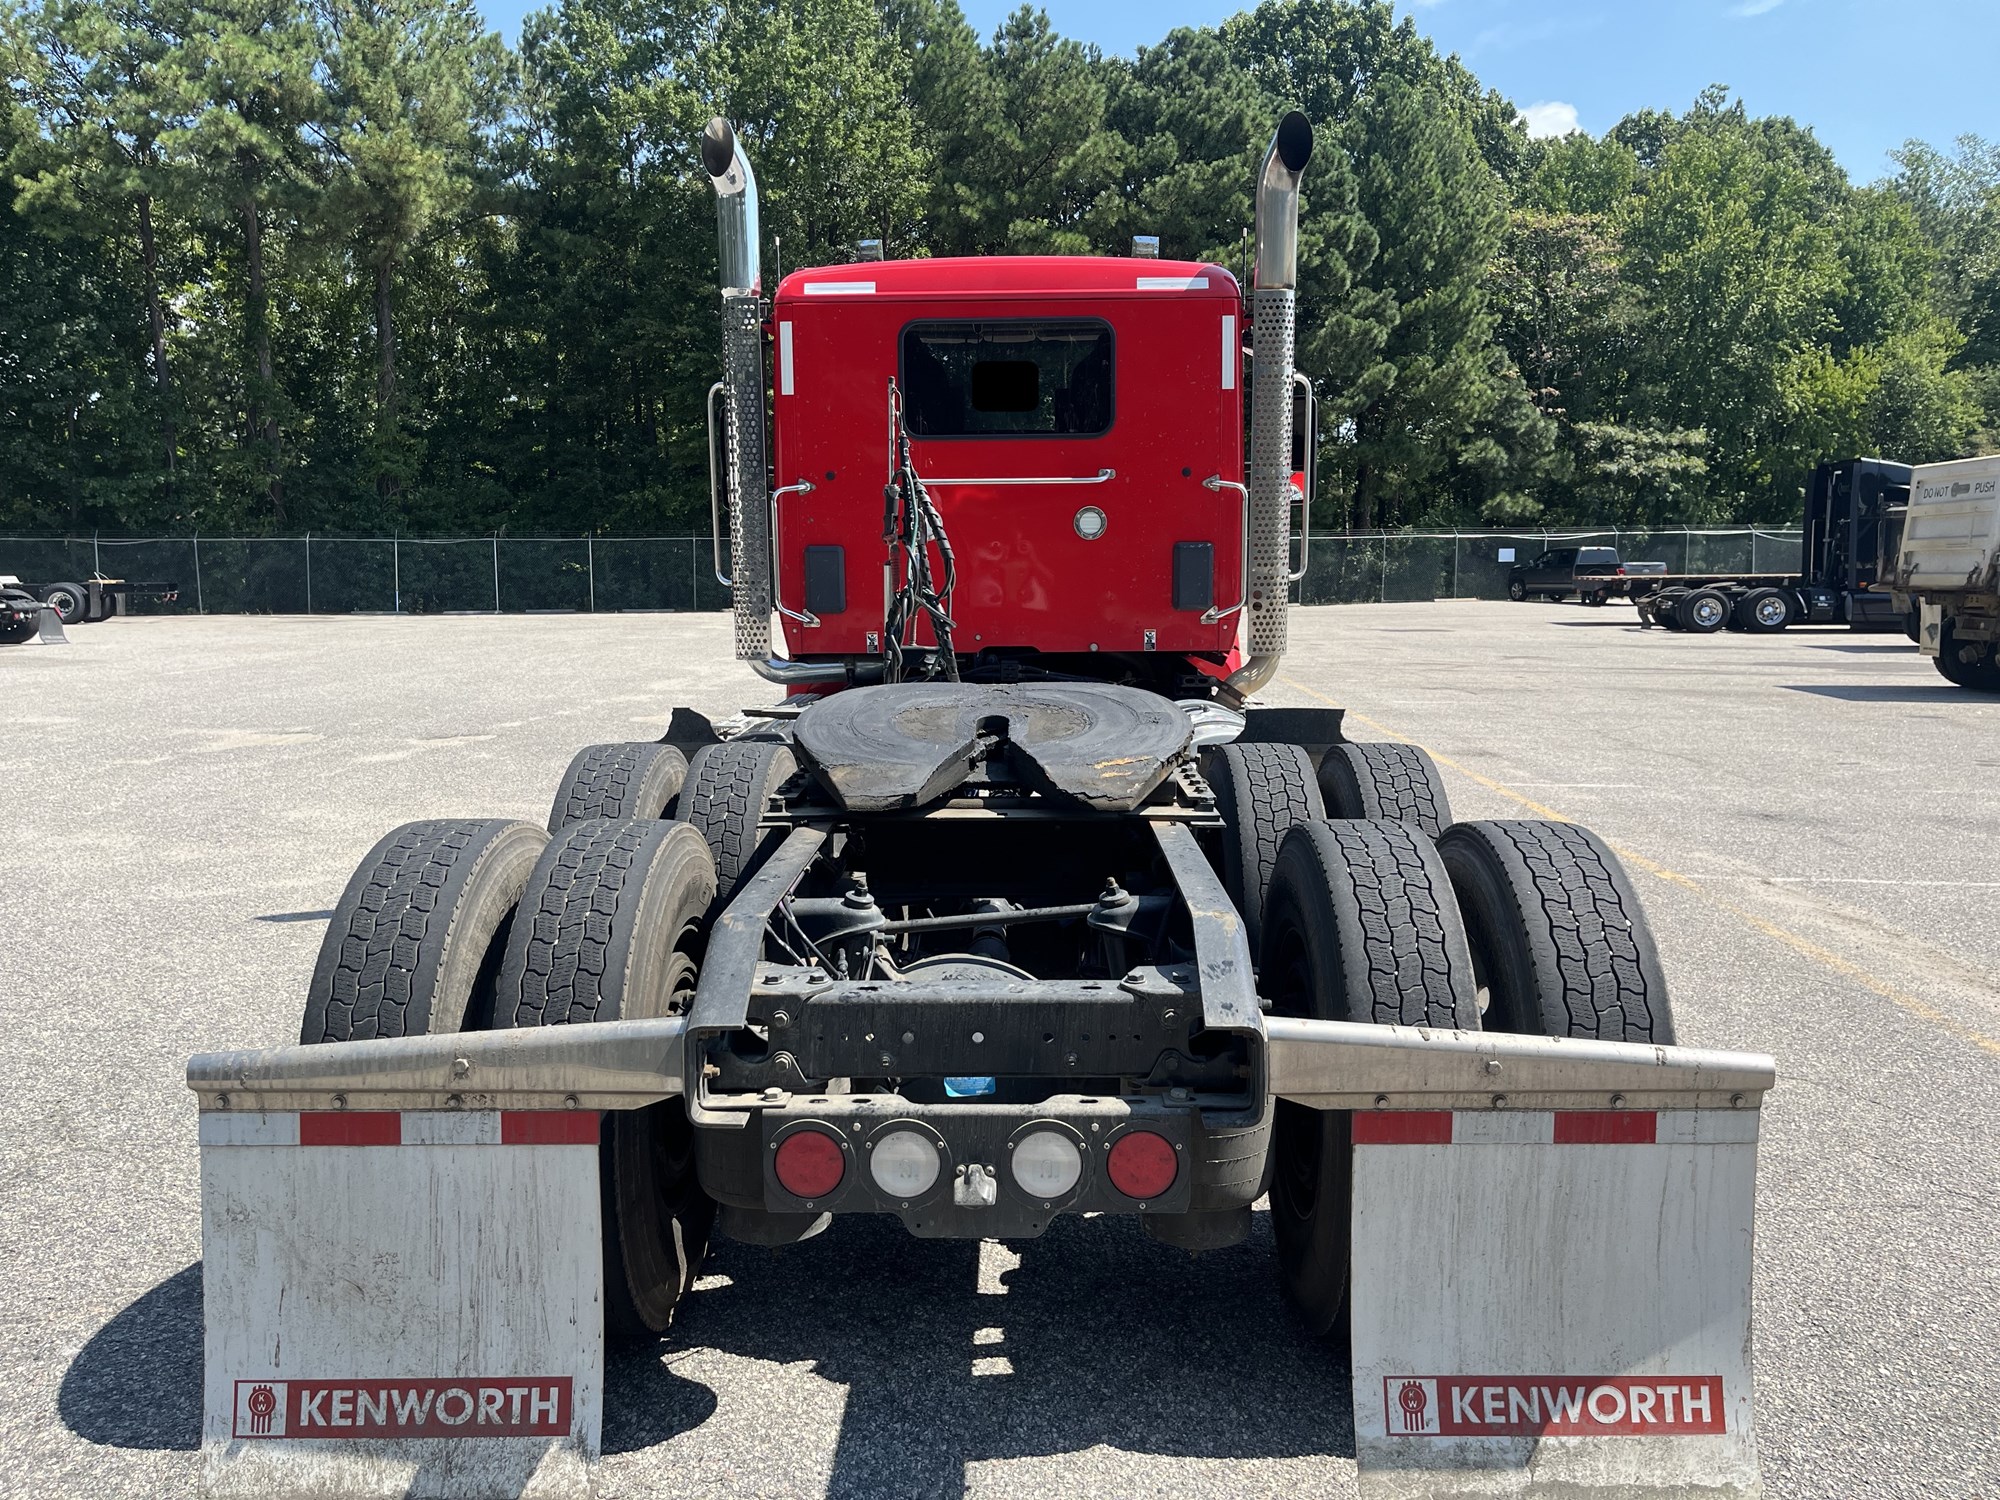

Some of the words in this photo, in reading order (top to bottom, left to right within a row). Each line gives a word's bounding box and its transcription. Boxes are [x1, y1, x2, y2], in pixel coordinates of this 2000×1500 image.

[1923, 488, 1934, 499] DO
[1934, 486, 1950, 498] NOT
[1974, 481, 1996, 493] PUSH
[258, 1394, 265, 1402] K
[1408, 1390, 1415, 1398] K
[257, 1403, 267, 1411] W
[300, 1387, 559, 1427] KENWORTH
[1408, 1400, 1418, 1408] W
[1451, 1385, 1712, 1425] KENWORTH
